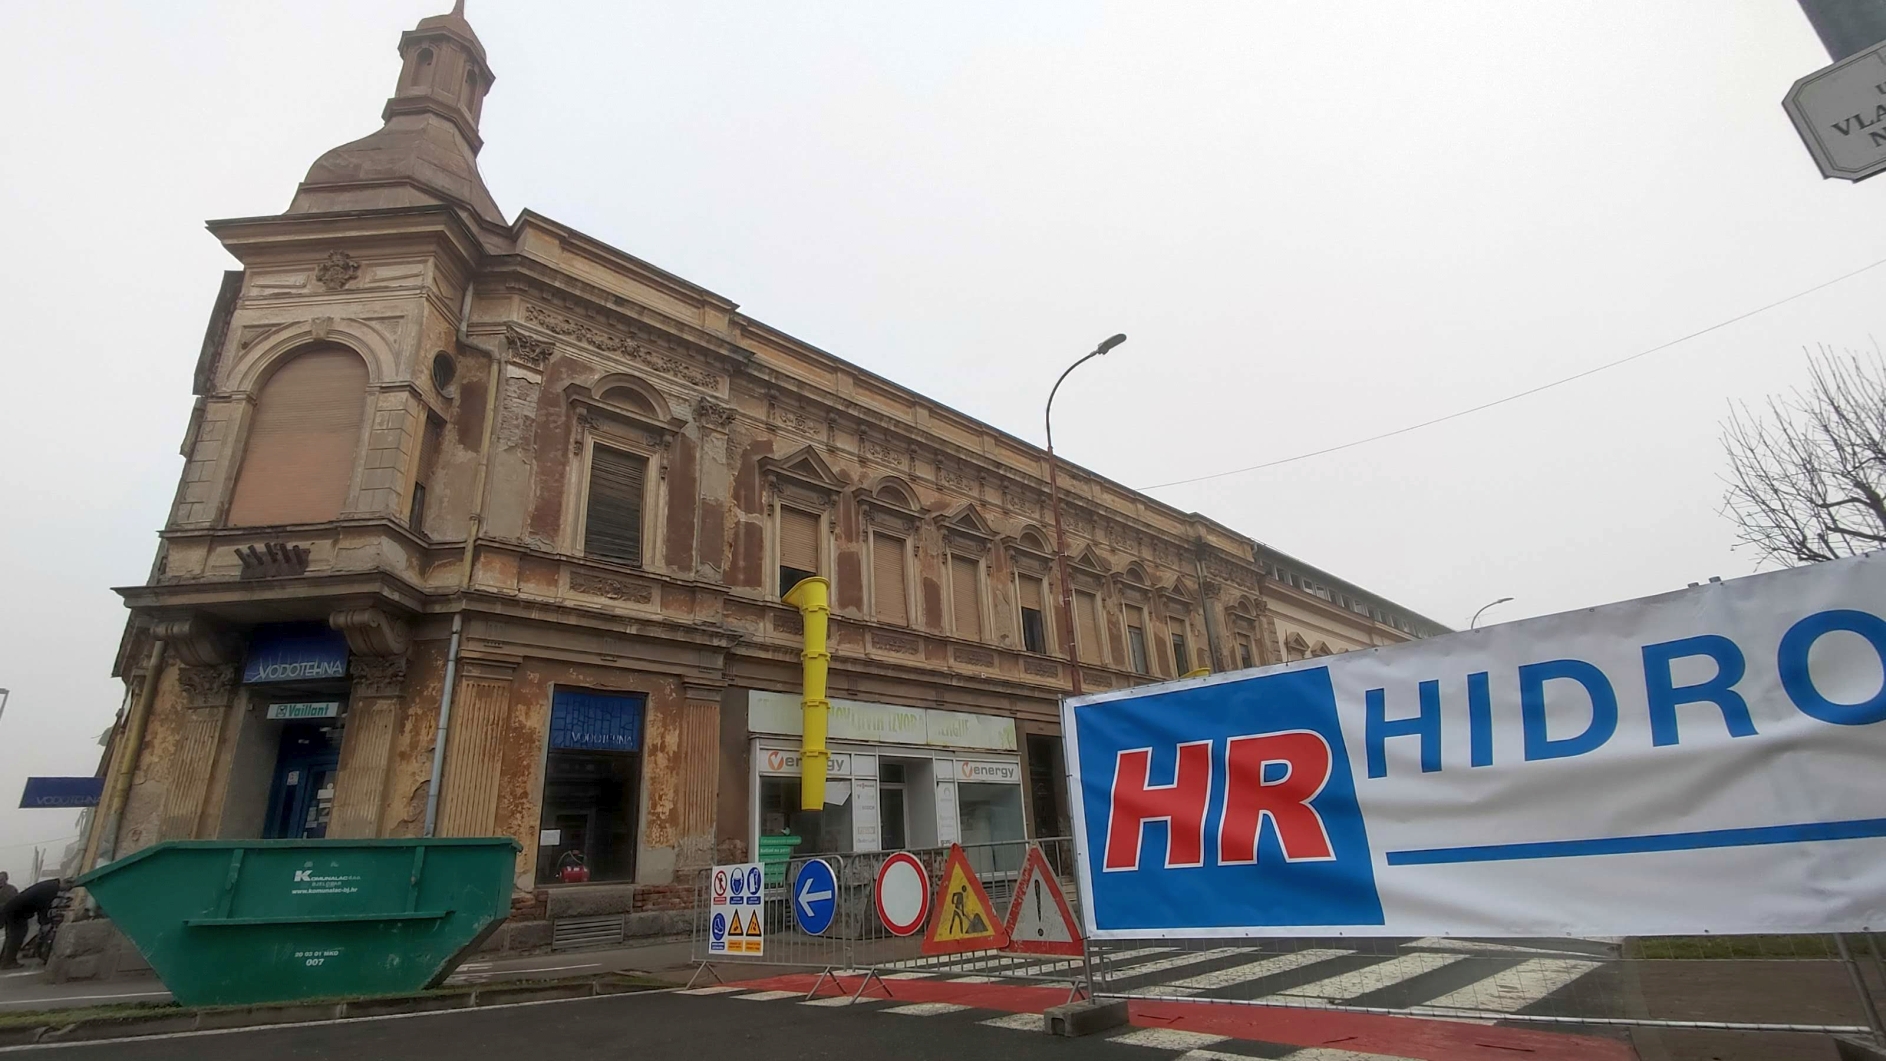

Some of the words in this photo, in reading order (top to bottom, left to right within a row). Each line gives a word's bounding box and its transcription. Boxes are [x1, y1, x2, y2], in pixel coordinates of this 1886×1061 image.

[260, 661, 342, 679] VODOTEHNA
[1365, 609, 1886, 779] HIDRO
[288, 704, 329, 717] Vaillant
[1103, 729, 1337, 872] HR
[305, 958, 325, 966] 007
